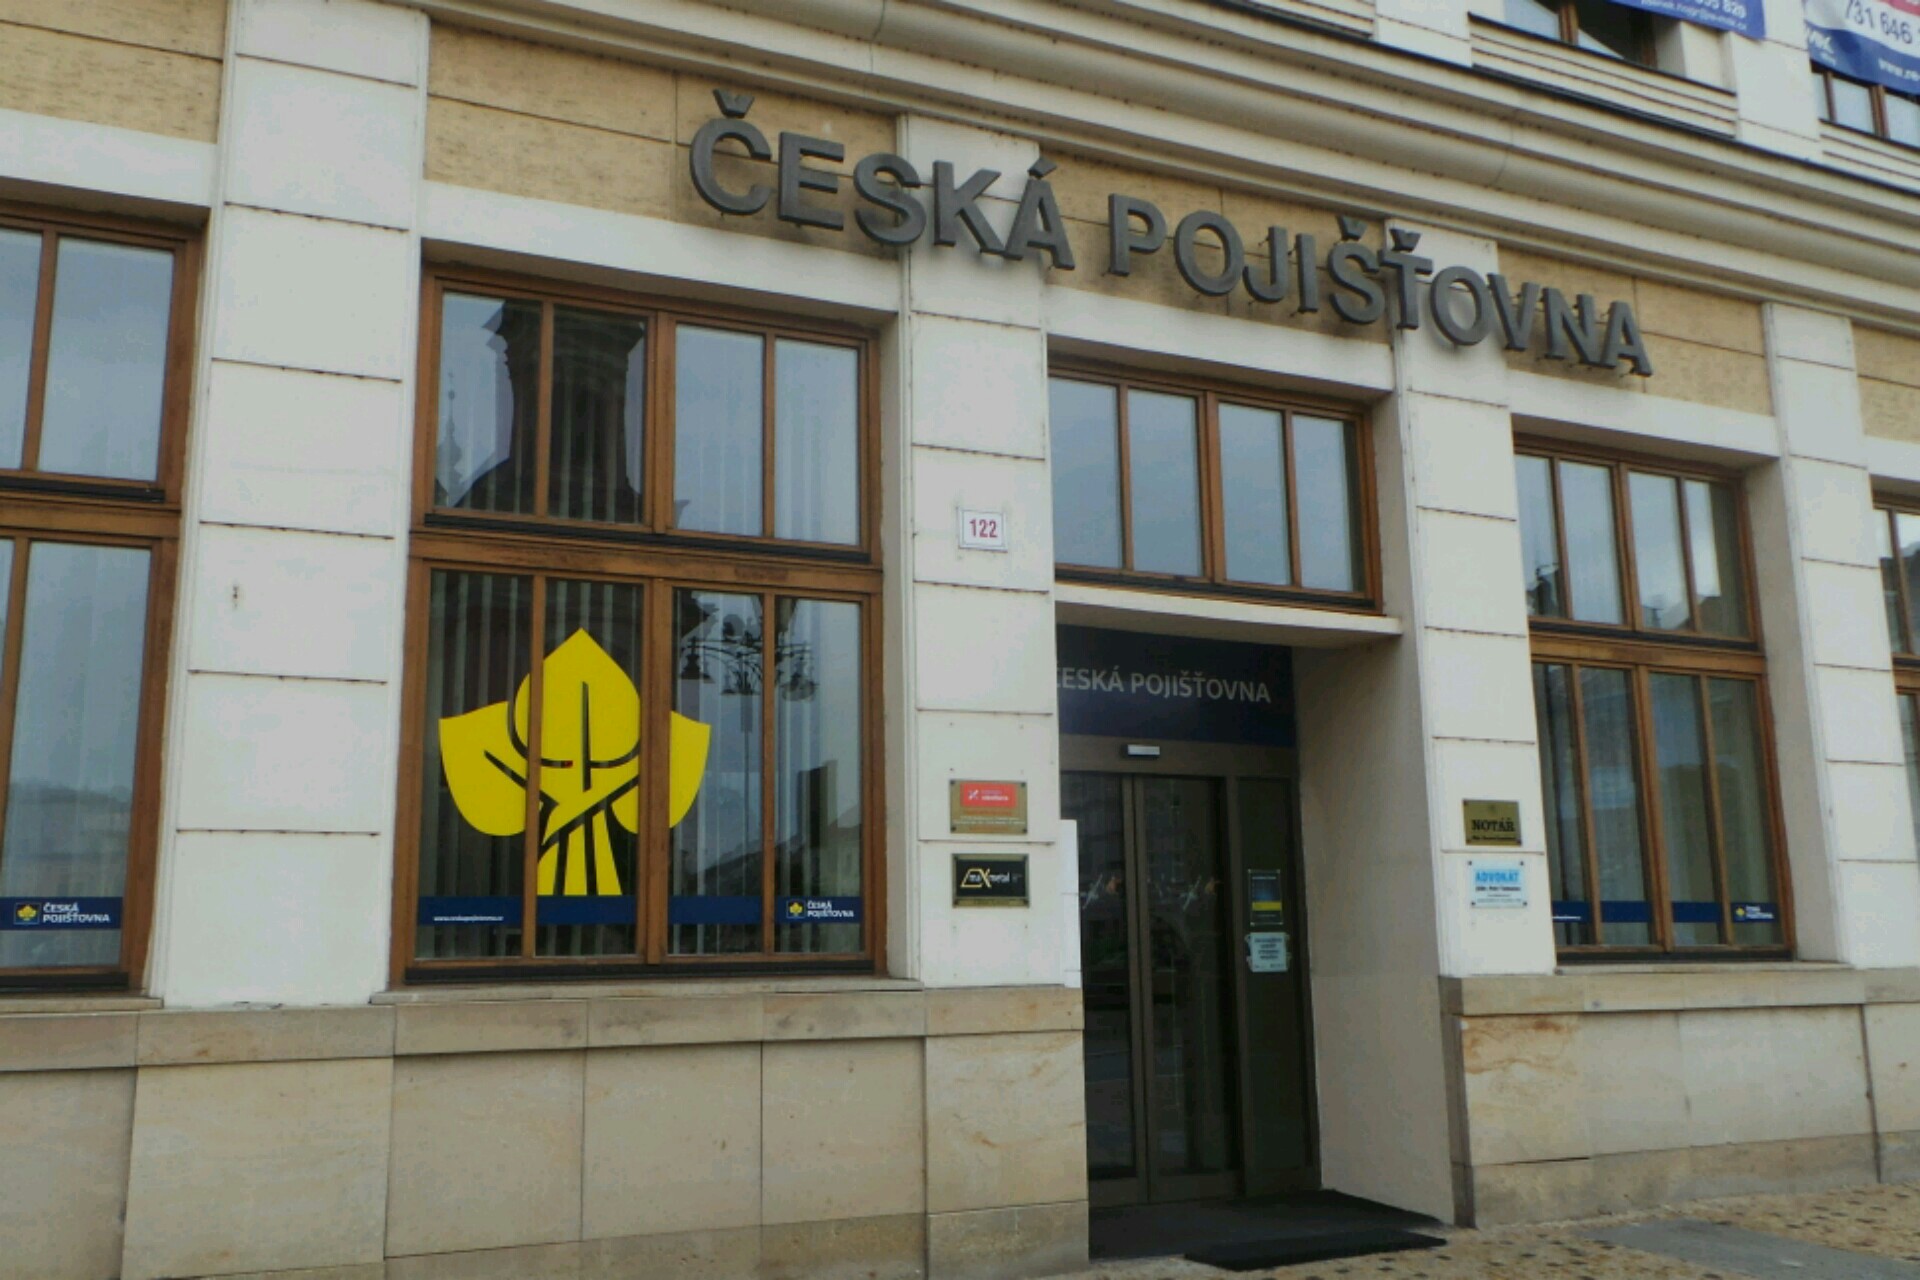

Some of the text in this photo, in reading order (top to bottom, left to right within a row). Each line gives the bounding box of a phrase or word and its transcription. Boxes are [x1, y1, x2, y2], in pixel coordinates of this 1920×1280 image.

[1880, 11, 1913, 45] 646
[689, 88, 1654, 377] ČESKÁ POJIŠŤOVNA
[969, 518, 999, 538] 122
[1057, 665, 1272, 704] ESKÁ POJIŠŤOVNA
[42, 901, 80, 913] ČESKÁ
